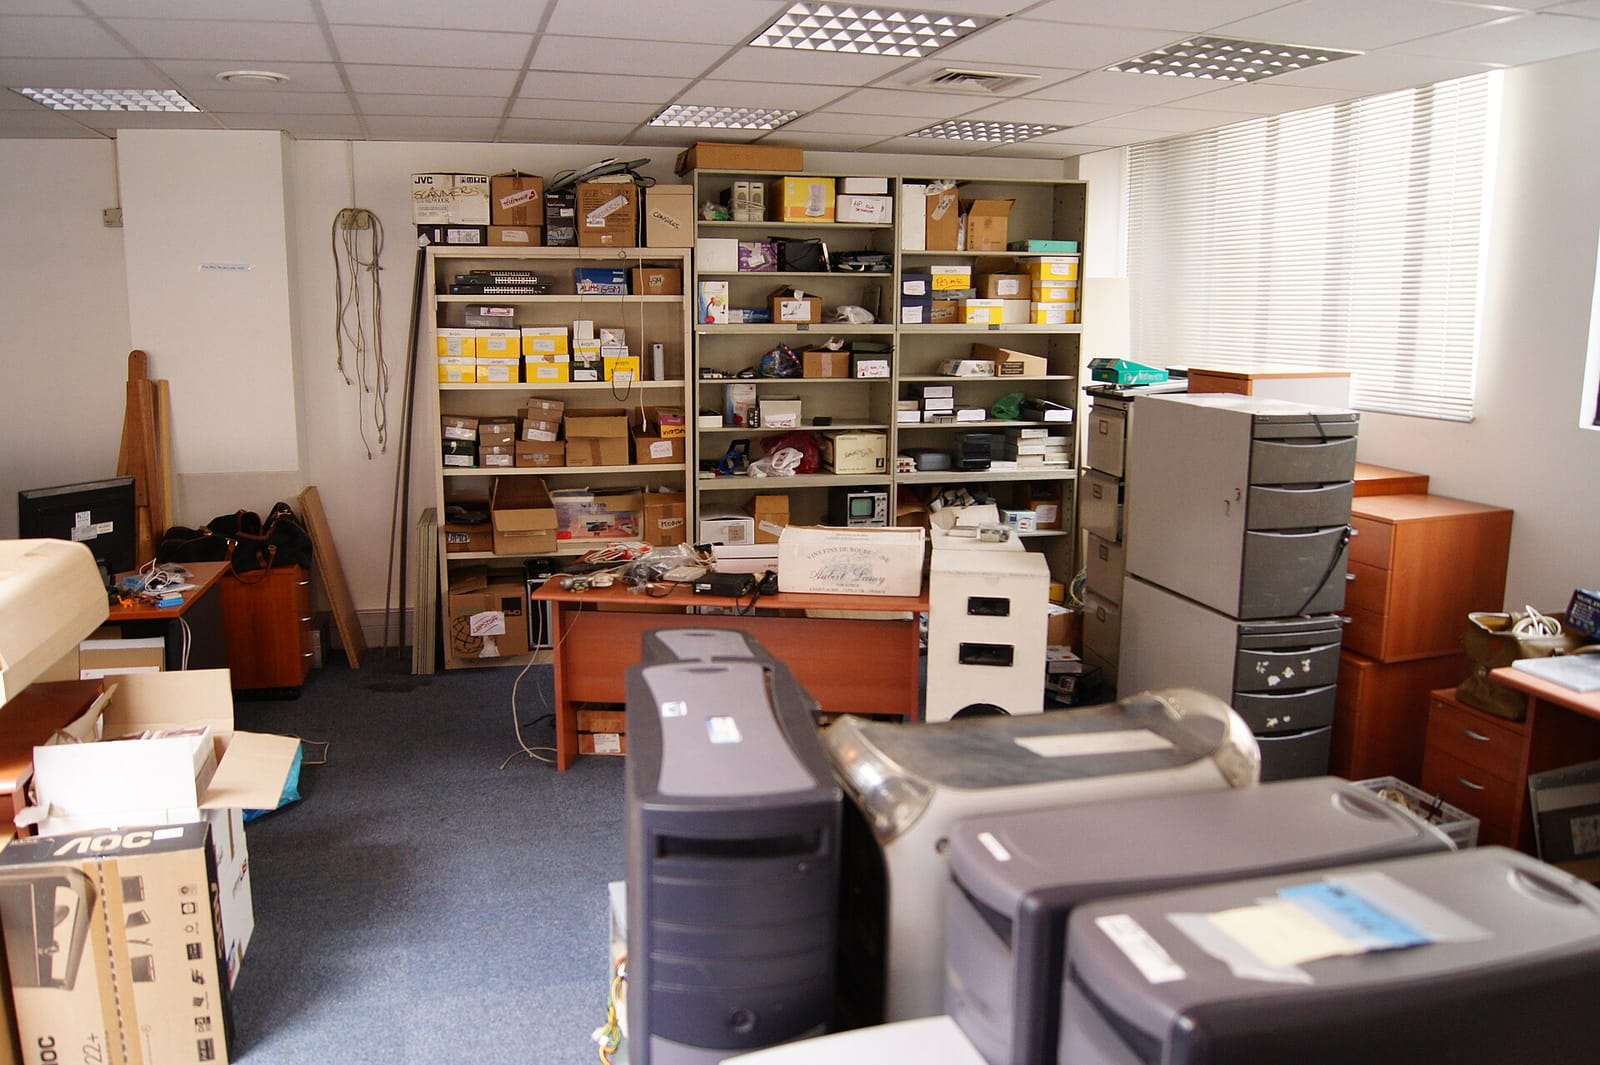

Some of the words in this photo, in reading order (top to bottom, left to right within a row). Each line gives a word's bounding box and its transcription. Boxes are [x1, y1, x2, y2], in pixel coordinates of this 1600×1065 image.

[414, 176, 433, 184] JVC
[53, 830, 154, 857] AOC
[37, 1035, 58, 1065] OC
